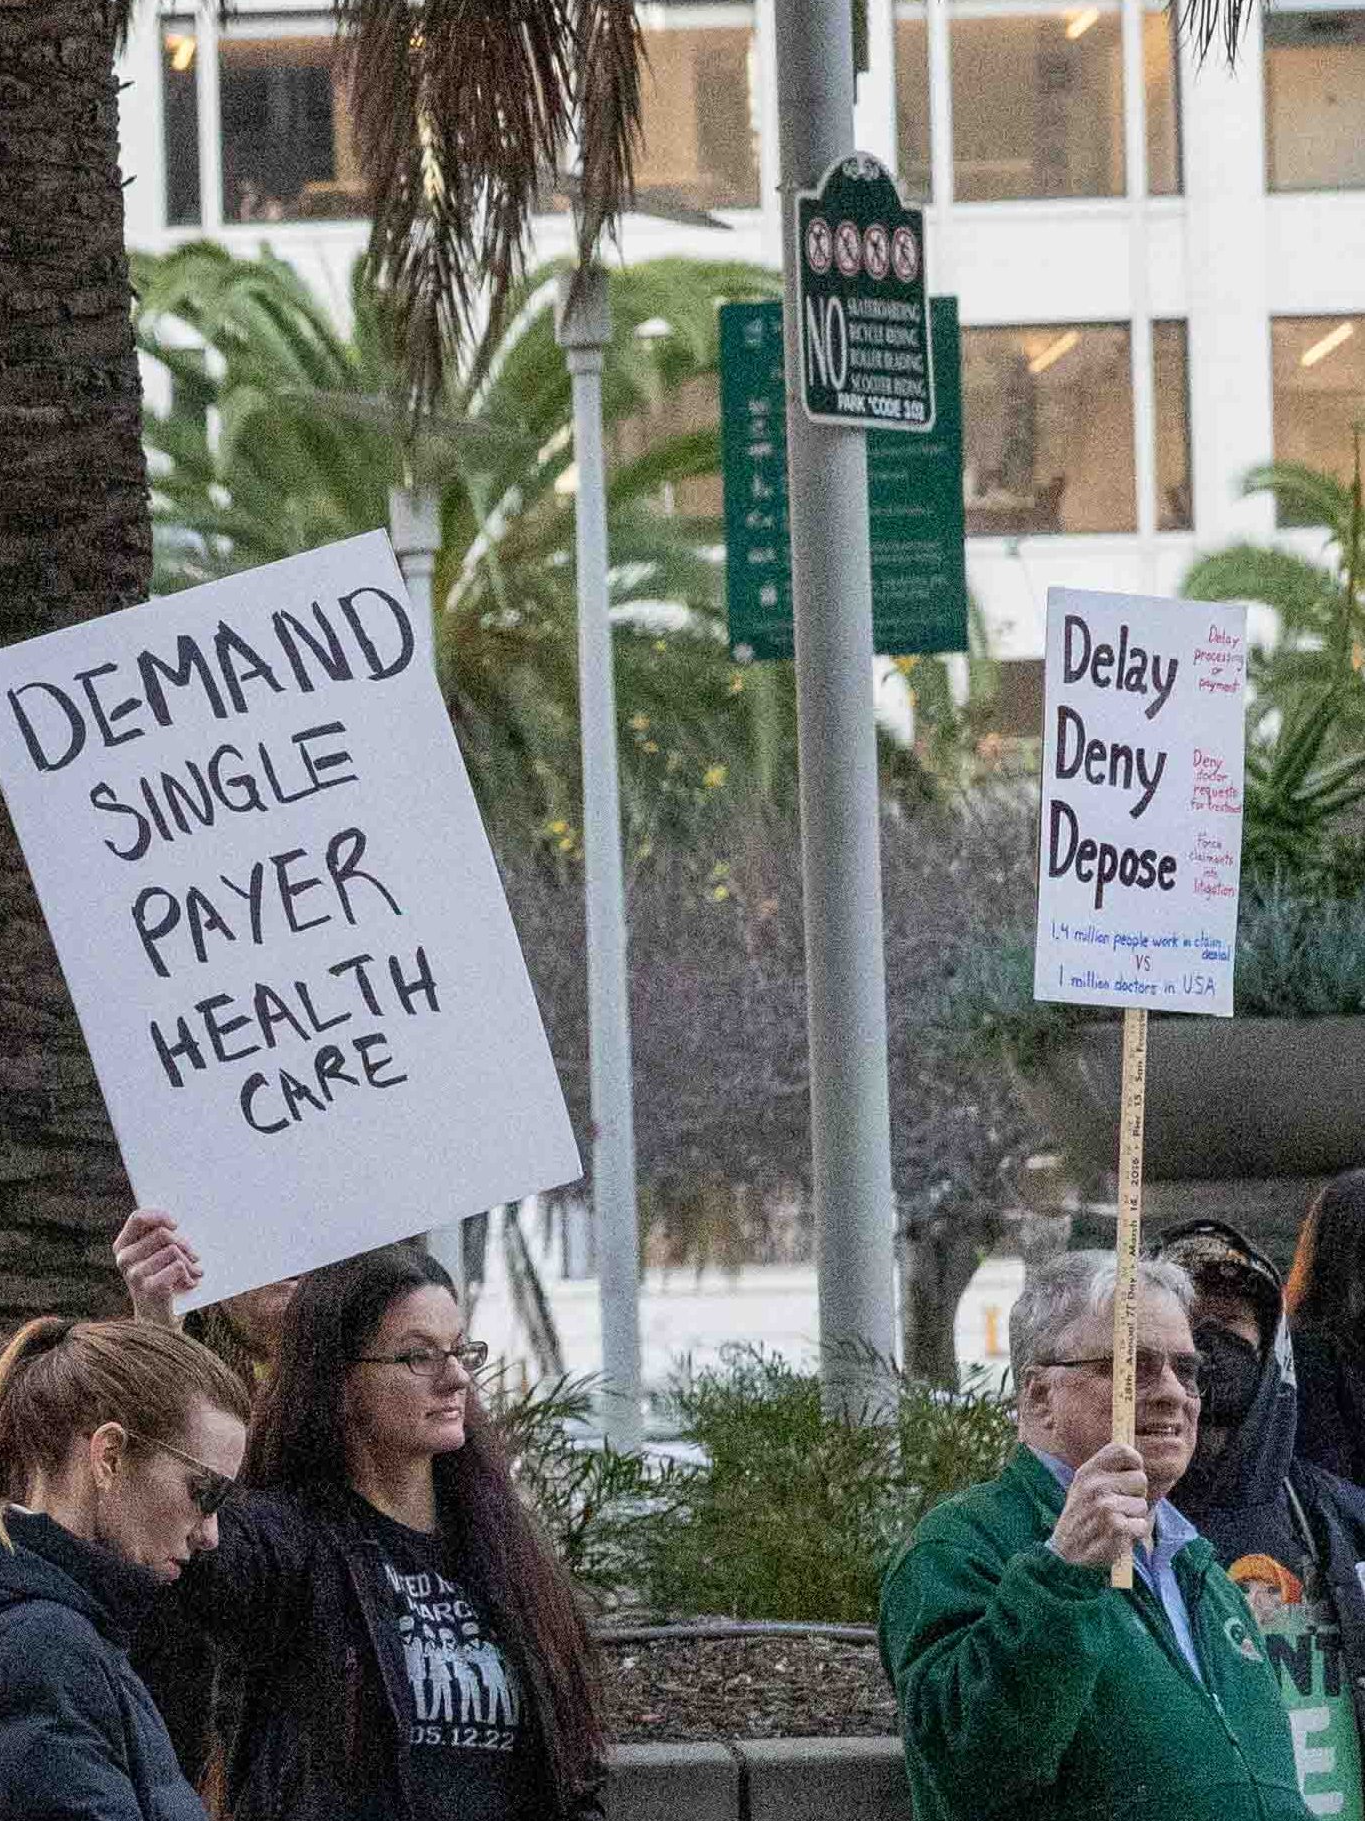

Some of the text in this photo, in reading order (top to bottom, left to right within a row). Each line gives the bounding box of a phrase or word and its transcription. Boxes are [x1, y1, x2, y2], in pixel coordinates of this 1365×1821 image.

[806, 295, 847, 390] NO
[7, 586, 415, 772] DEMAND
[1063, 615, 1179, 720] Delay
[1208, 624, 1241, 649] Delay
[91, 721, 360, 861] SINGLE
[1055, 705, 1168, 819] Deny
[1193, 749, 1224, 774] Deny
[131, 827, 402, 978] PAYER
[1048, 799, 1177, 910] Depose
[1051, 921, 1069, 941] 1.4
[1074, 925, 1110, 945] million
[1113, 931, 1149, 952] people
[1153, 932, 1179, 948] work
[1071, 970, 1110, 990] million
[1113, 973, 1158, 996] doctors
[1164, 981, 1176, 995] in
[1183, 973, 1216, 997] USA
[151, 946, 441, 1088] HEALTH
[240, 1034, 408, 1134] CARE
[1135, 1060, 1145, 1083] San
